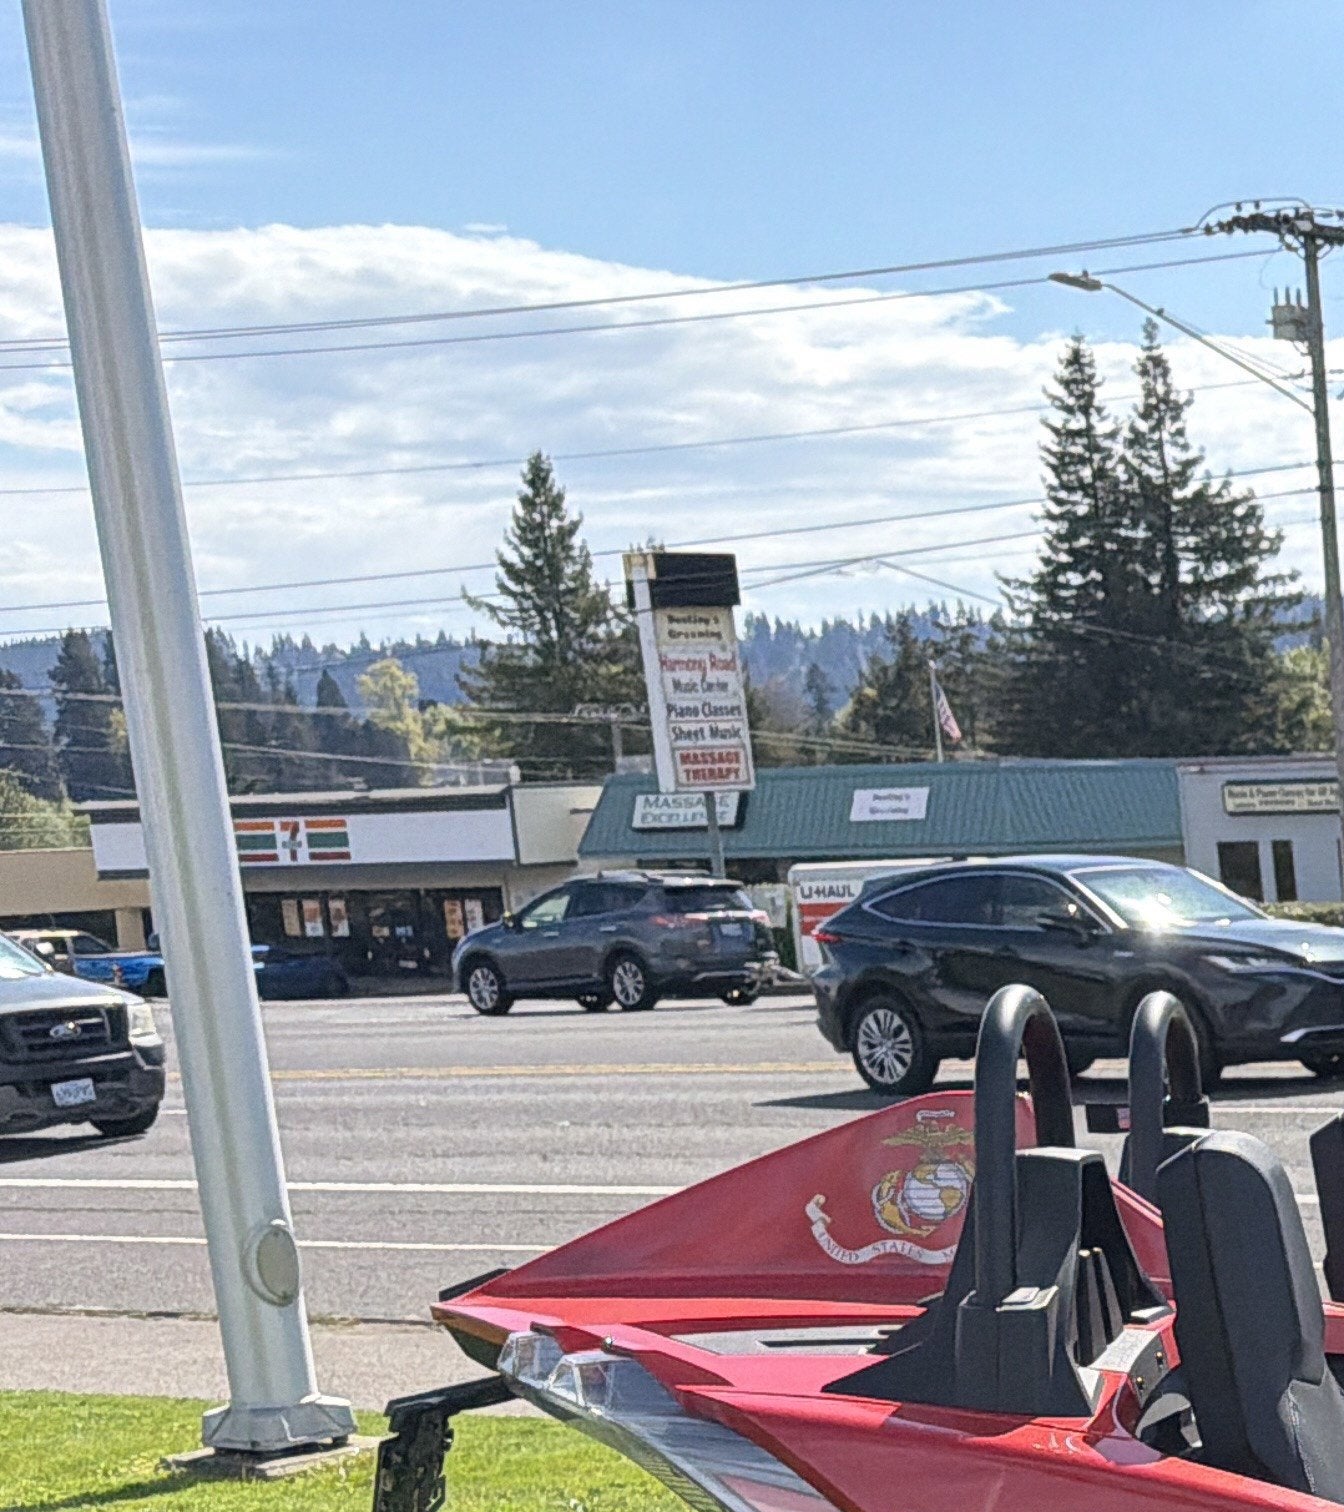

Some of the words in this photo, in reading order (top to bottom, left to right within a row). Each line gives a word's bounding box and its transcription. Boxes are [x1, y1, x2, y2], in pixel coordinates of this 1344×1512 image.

[709, 651, 736, 671] Road
[672, 679, 698, 693] Music
[666, 703, 699, 719] Piano
[702, 702, 741, 718] Classes
[672, 726, 704, 741] Sheet
[709, 723, 741, 739] Music
[680, 752, 740, 765] MASSAGE
[684, 768, 739, 781] THERAPY
[643, 795, 730, 809] MASSAE
[872, 1240, 924, 1259] STATES
